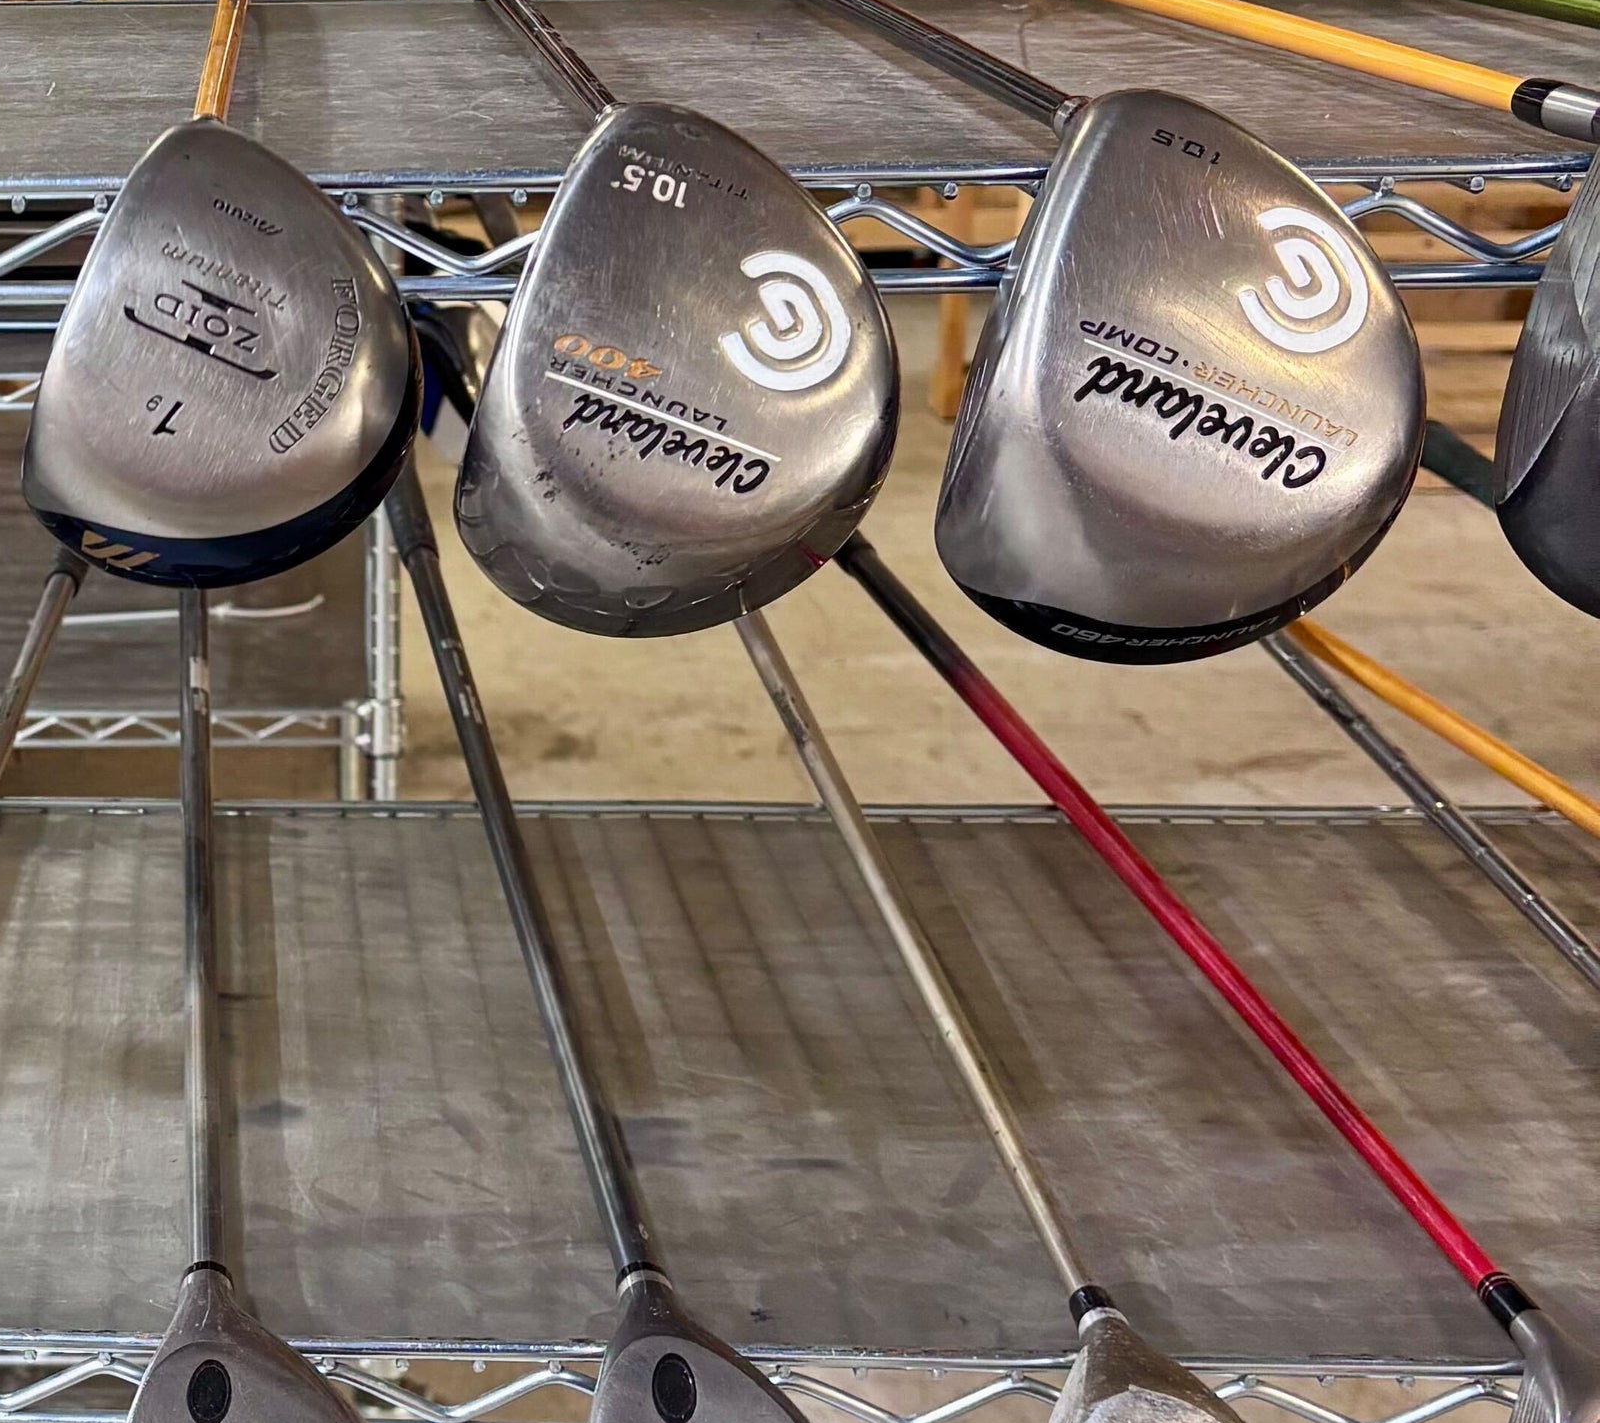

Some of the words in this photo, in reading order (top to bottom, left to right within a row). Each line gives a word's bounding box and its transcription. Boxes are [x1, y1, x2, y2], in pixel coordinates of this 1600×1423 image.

[1150, 128, 1221, 165] 10.5
[618, 145, 748, 200] TITANIUM
[268, 277, 362, 454] FORGED
[554, 334, 662, 379] 400
[152, 401, 184, 436] 1
[551, 356, 728, 431] LAUNCHER
[562, 393, 771, 495] Cleveland
[1073, 355, 1327, 489] Cleveland
[1051, 623, 1126, 644] 460
[1125, 614, 1280, 648] LAUNCHER
